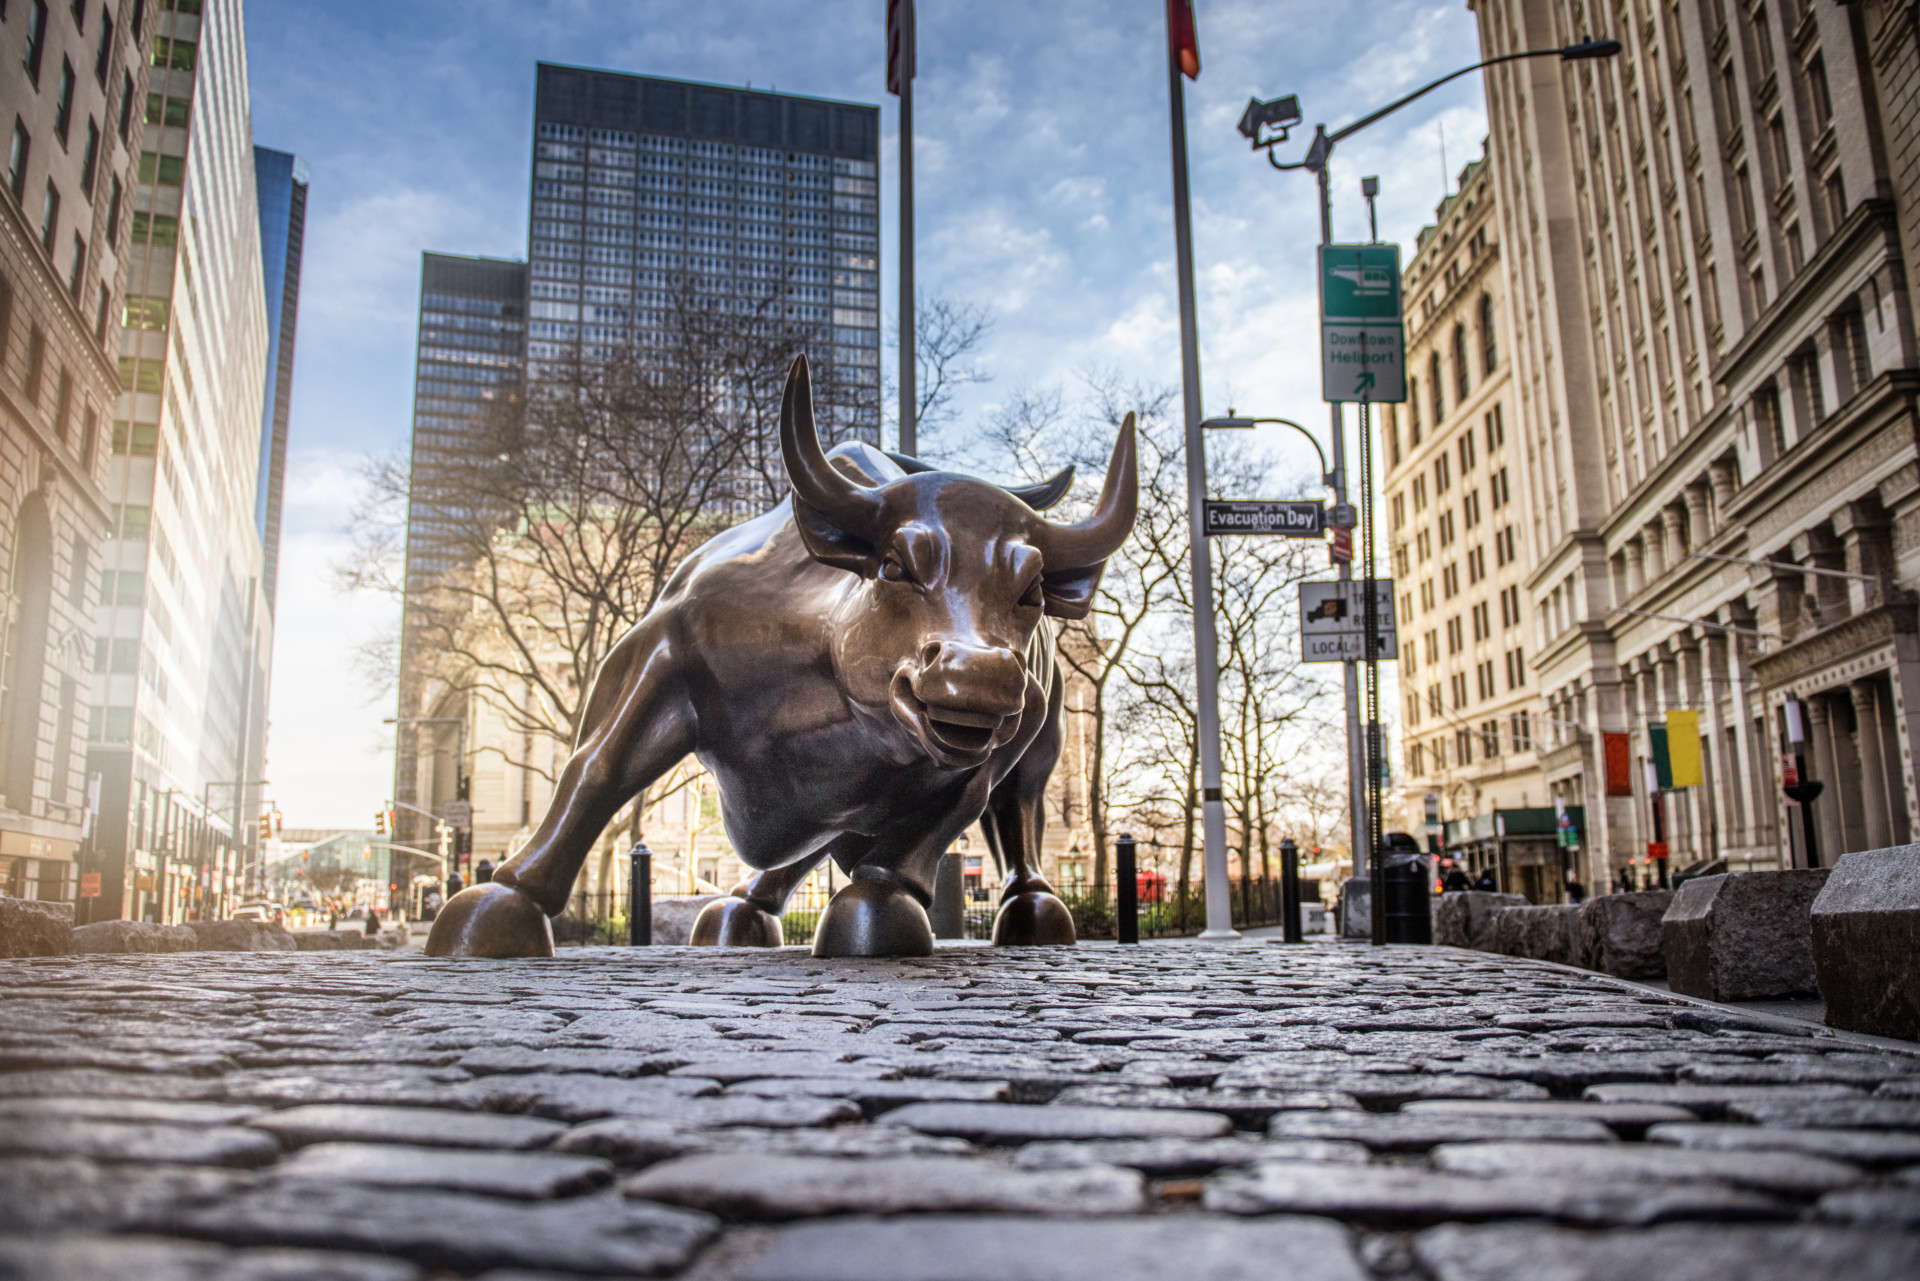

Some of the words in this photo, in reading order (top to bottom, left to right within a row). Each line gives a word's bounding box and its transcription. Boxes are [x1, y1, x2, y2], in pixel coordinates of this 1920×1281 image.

[1209, 510, 1285, 525] Evacuation
[1287, 510, 1314, 529] Day
[1312, 641, 1352, 655] LOCAL
